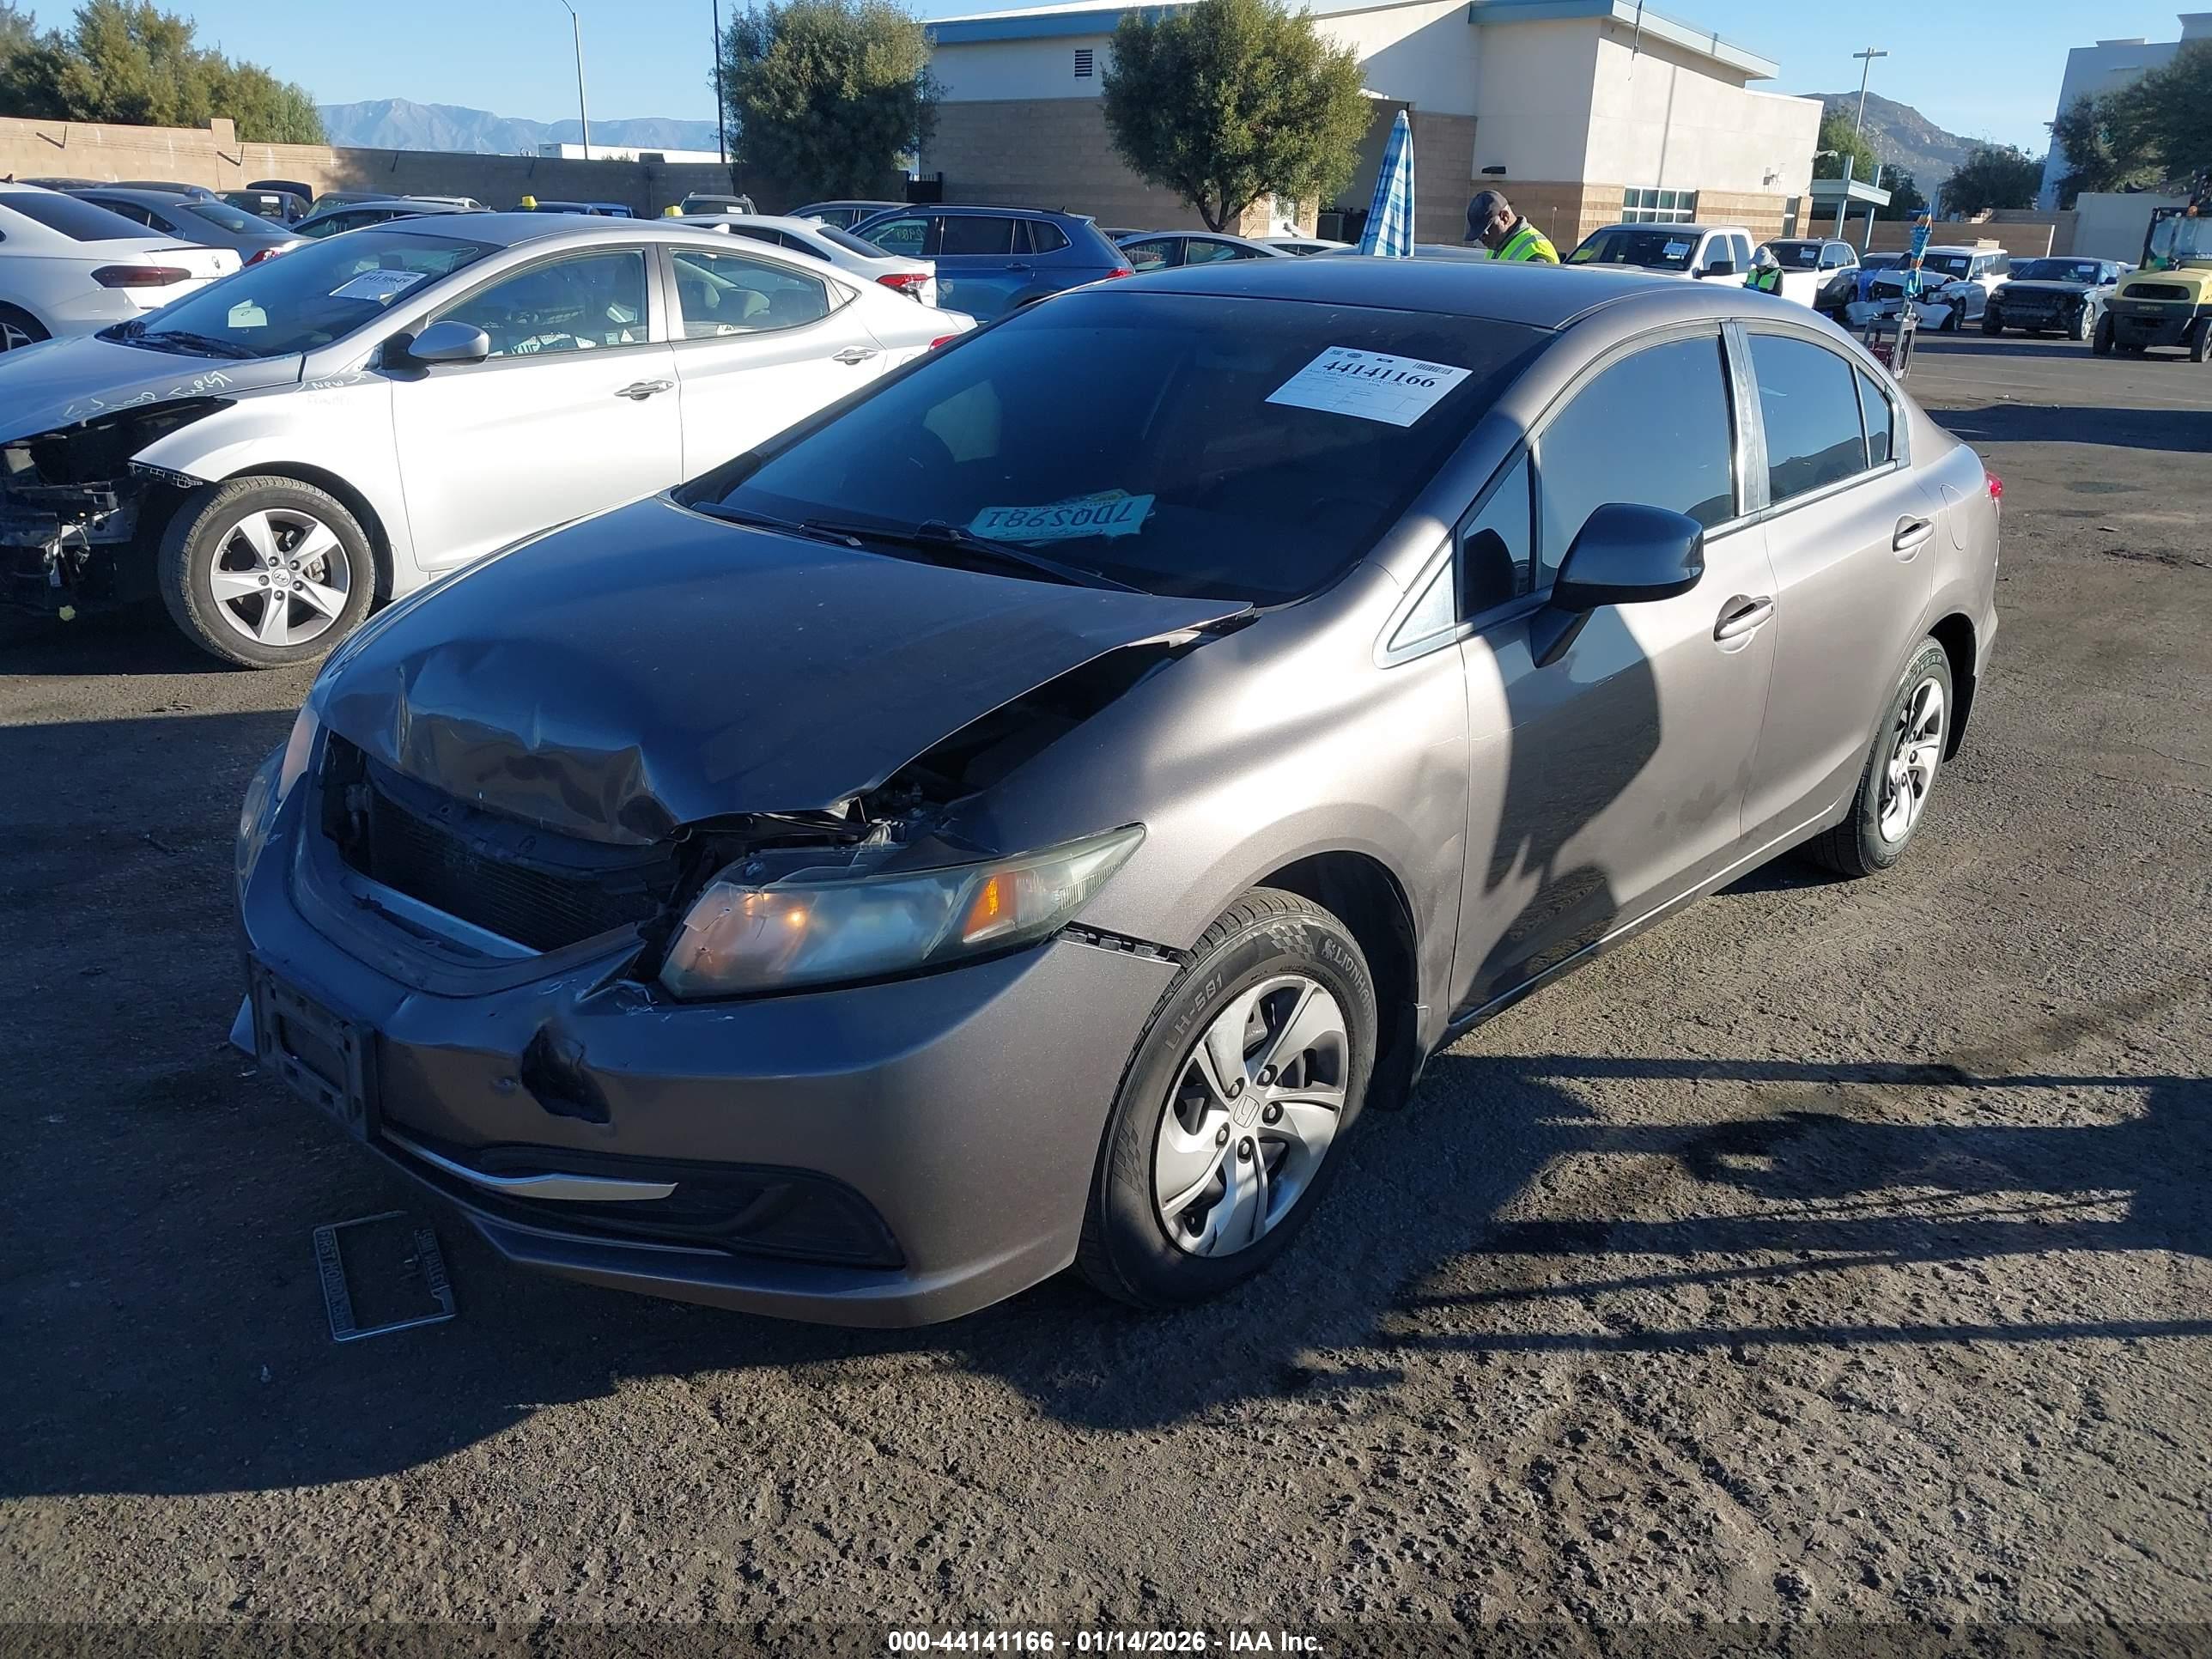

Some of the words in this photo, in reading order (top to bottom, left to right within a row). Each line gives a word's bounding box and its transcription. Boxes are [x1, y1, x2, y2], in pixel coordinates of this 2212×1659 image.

[1322, 360, 1437, 389] 44141166
[985, 501, 1134, 529] 7DQS981
[318, 1230, 337, 1261] FIRST
